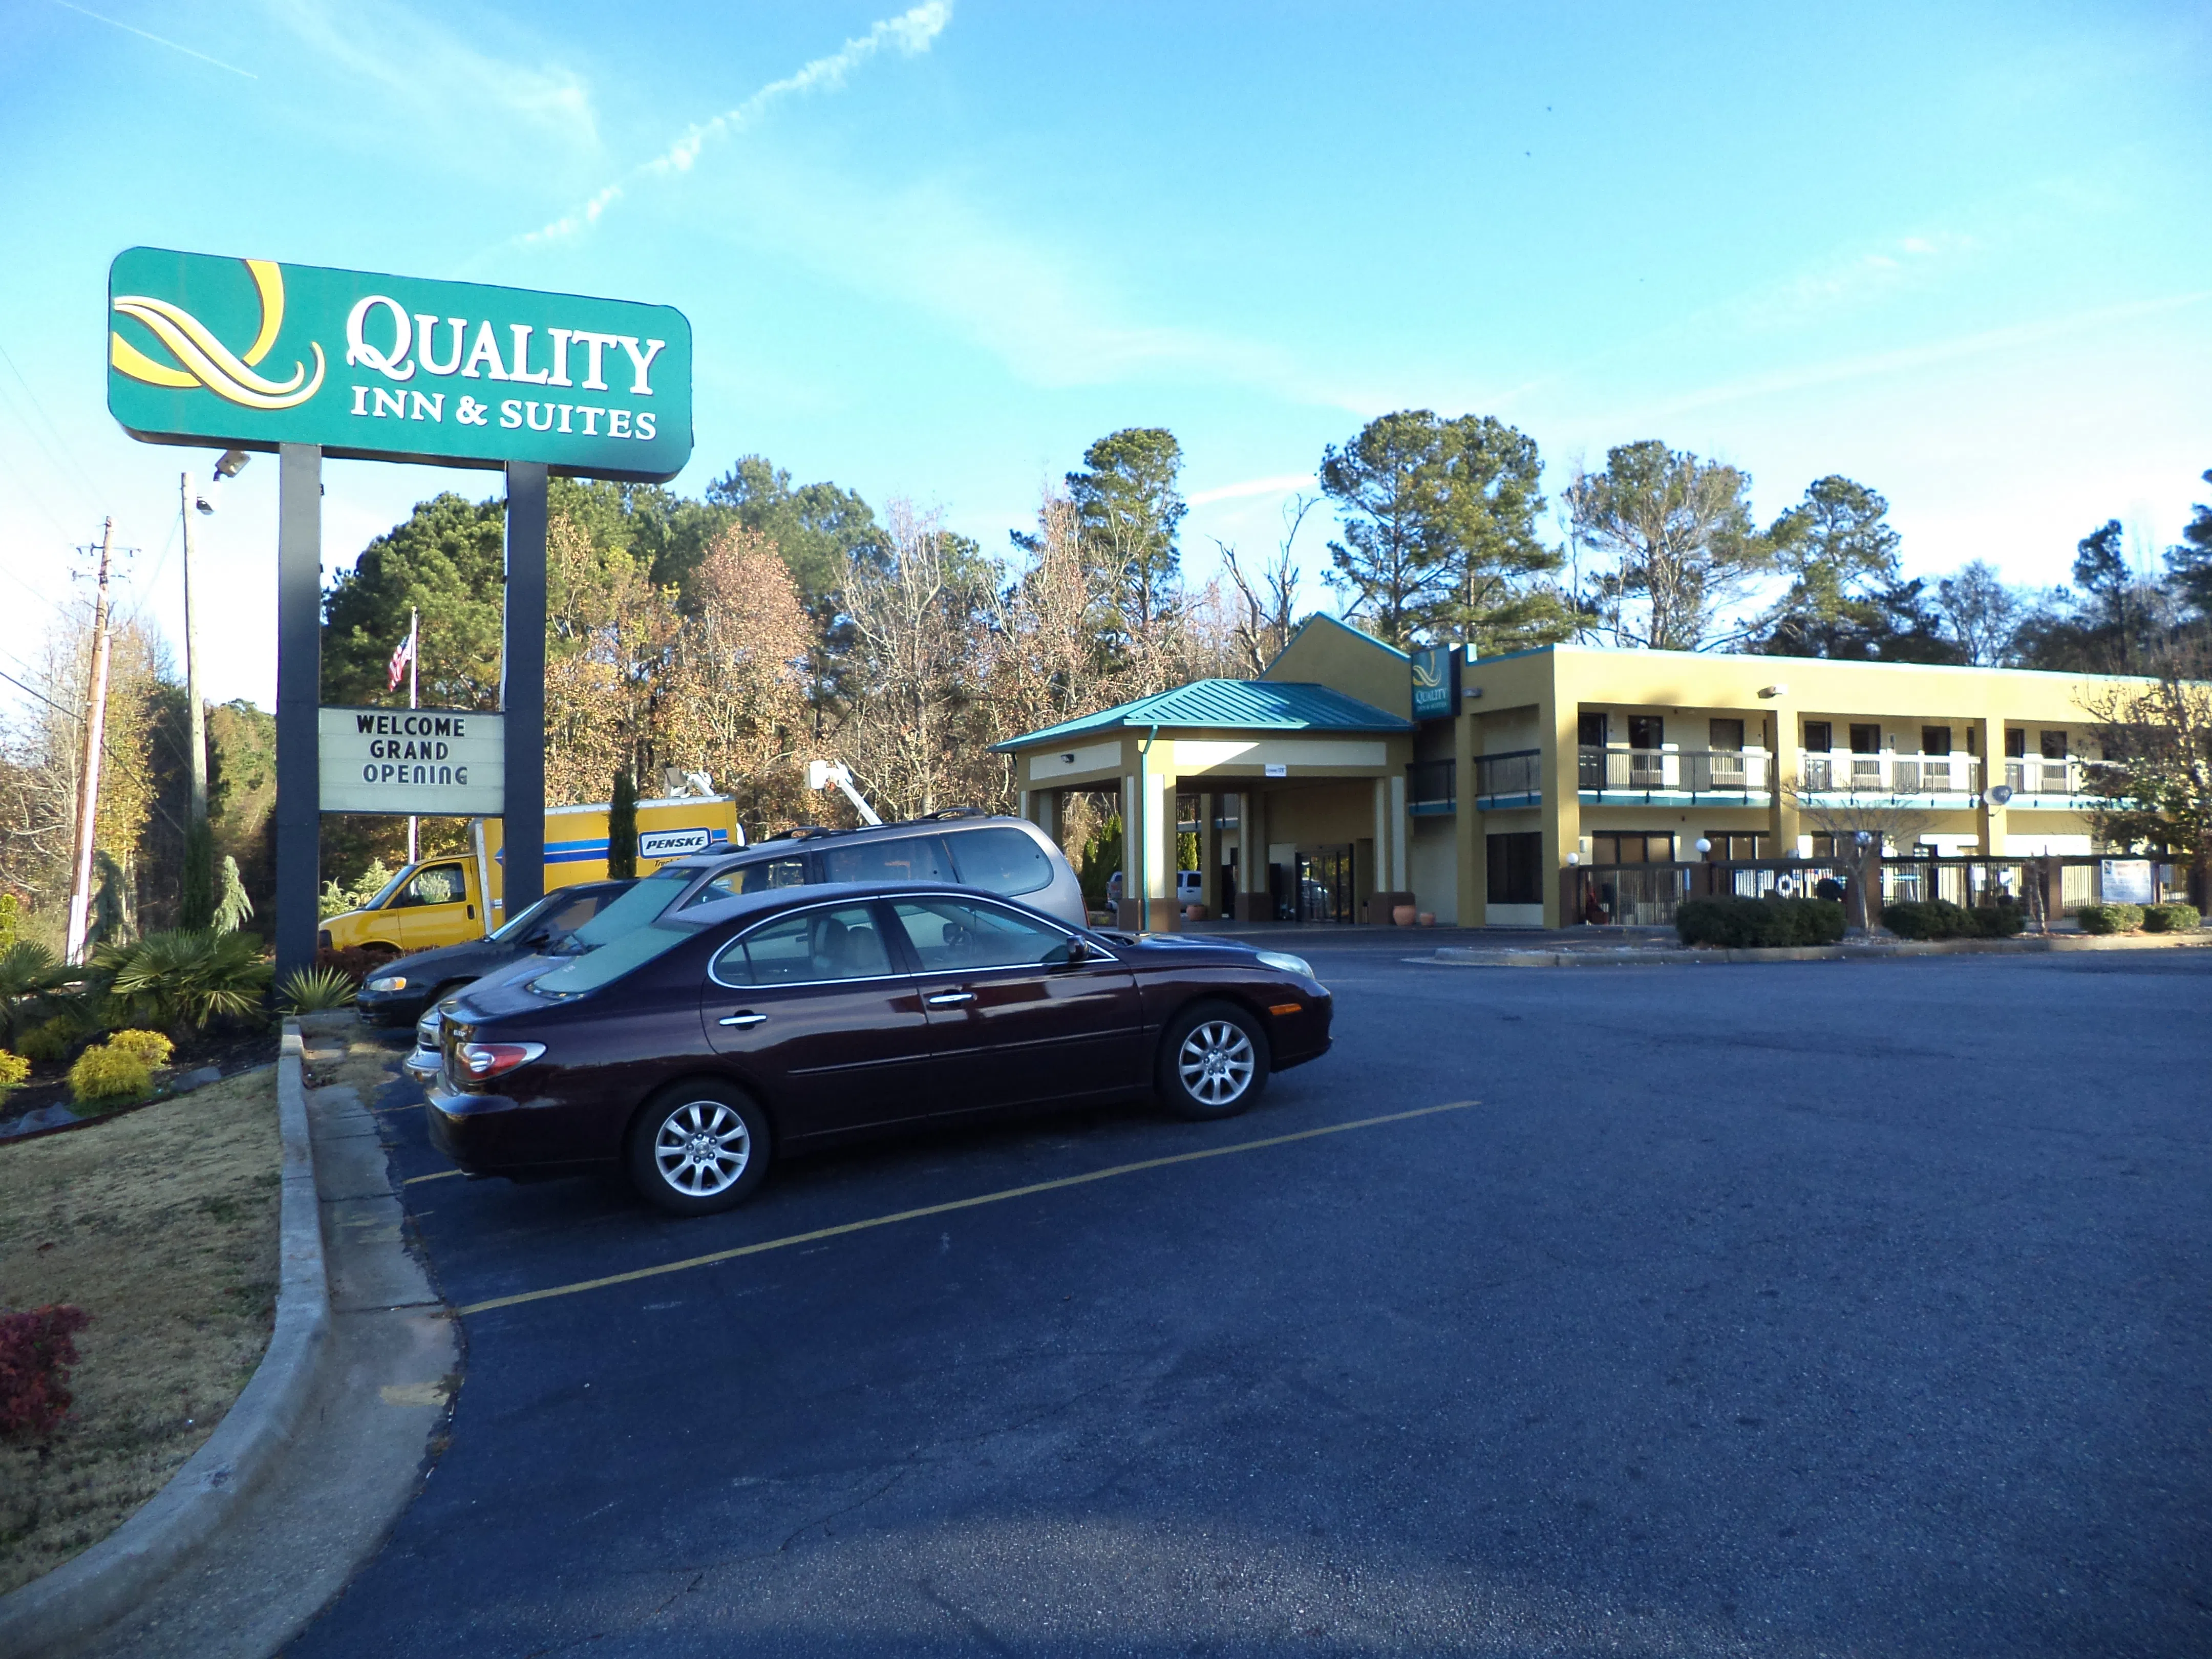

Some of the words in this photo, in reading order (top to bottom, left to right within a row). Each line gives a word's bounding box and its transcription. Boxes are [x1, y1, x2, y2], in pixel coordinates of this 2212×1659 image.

[346, 295, 665, 396] QUALITY
[350, 386, 445, 422] INN
[456, 395, 488, 427] &
[500, 399, 656, 441] SUITES
[356, 715, 465, 736] WELCOME
[370, 740, 449, 760] GRAND
[363, 763, 468, 785] OPENING
[645, 836, 705, 849] PENSKE
